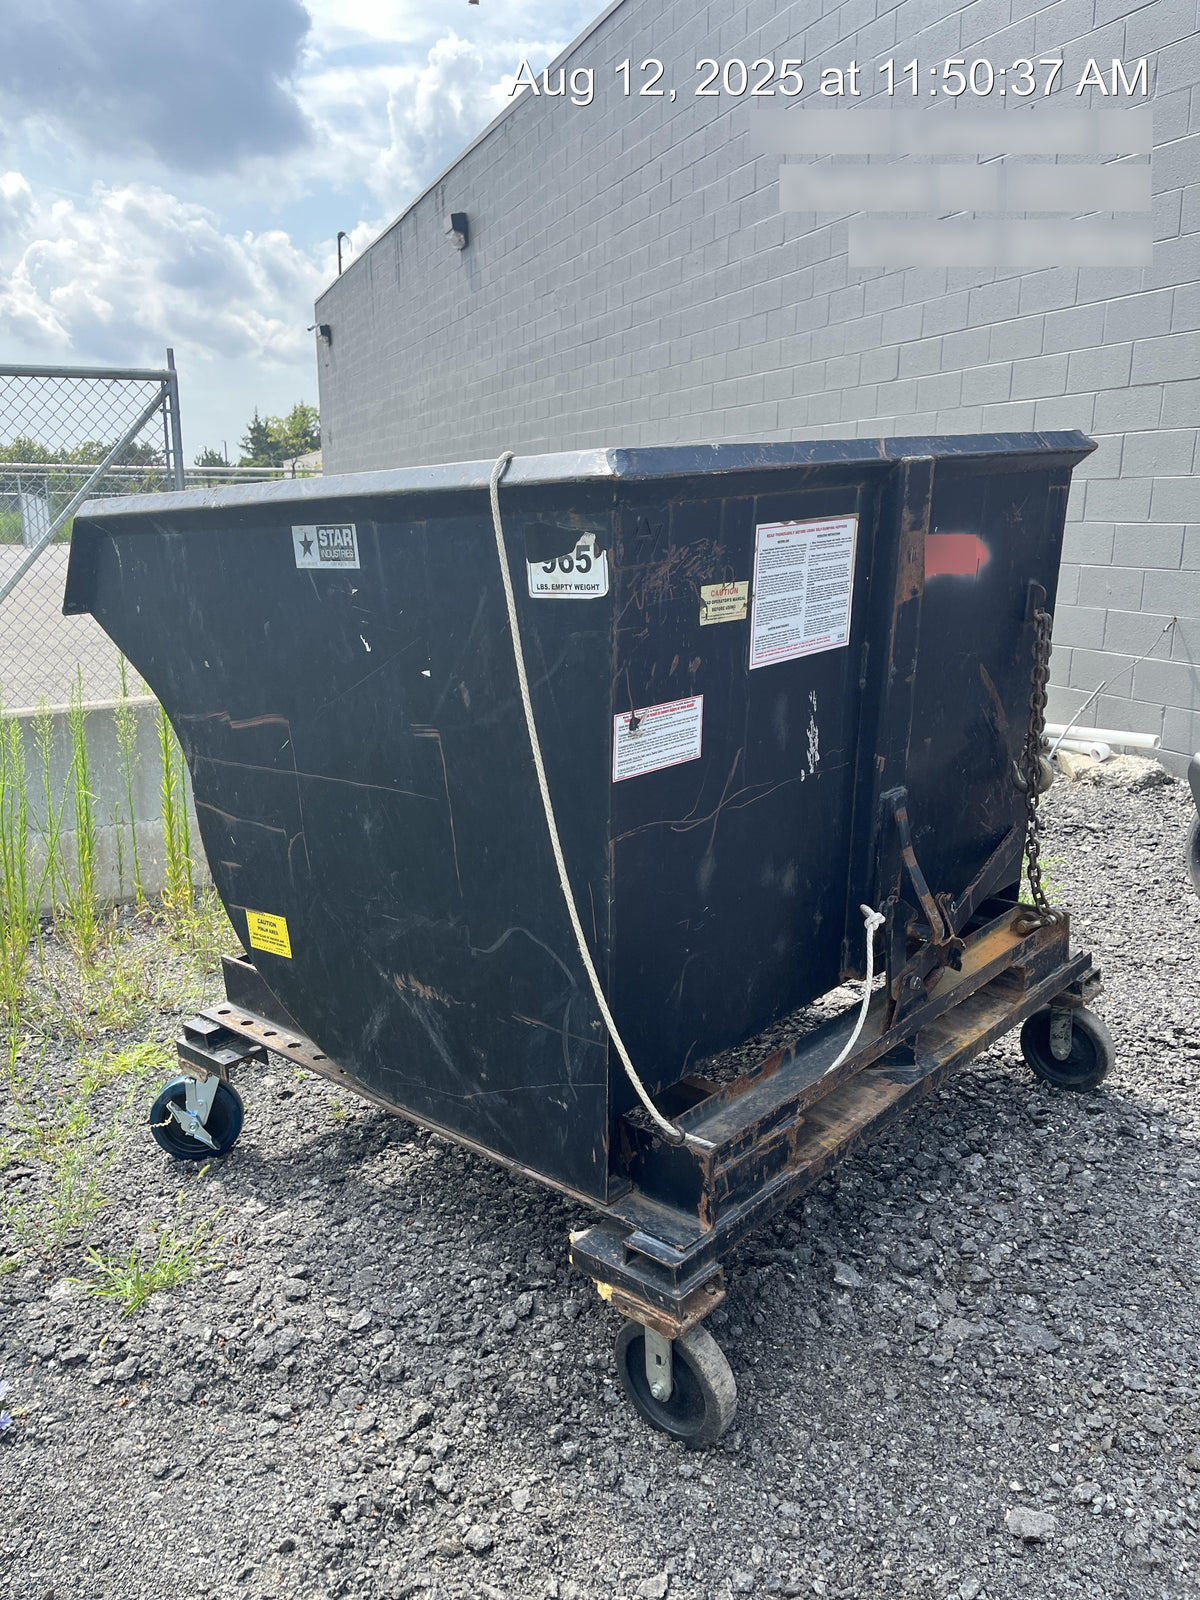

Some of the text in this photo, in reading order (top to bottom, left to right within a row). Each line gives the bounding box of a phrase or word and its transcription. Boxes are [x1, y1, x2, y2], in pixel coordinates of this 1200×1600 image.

[319, 529, 353, 547] STAR
[321, 549, 354, 558] INDUSTRIES
[536, 583, 600, 591] LBS. EMPTY WEIGHT
[711, 587, 739, 597] CAUTION
[257, 918, 277, 929] CAUTION
